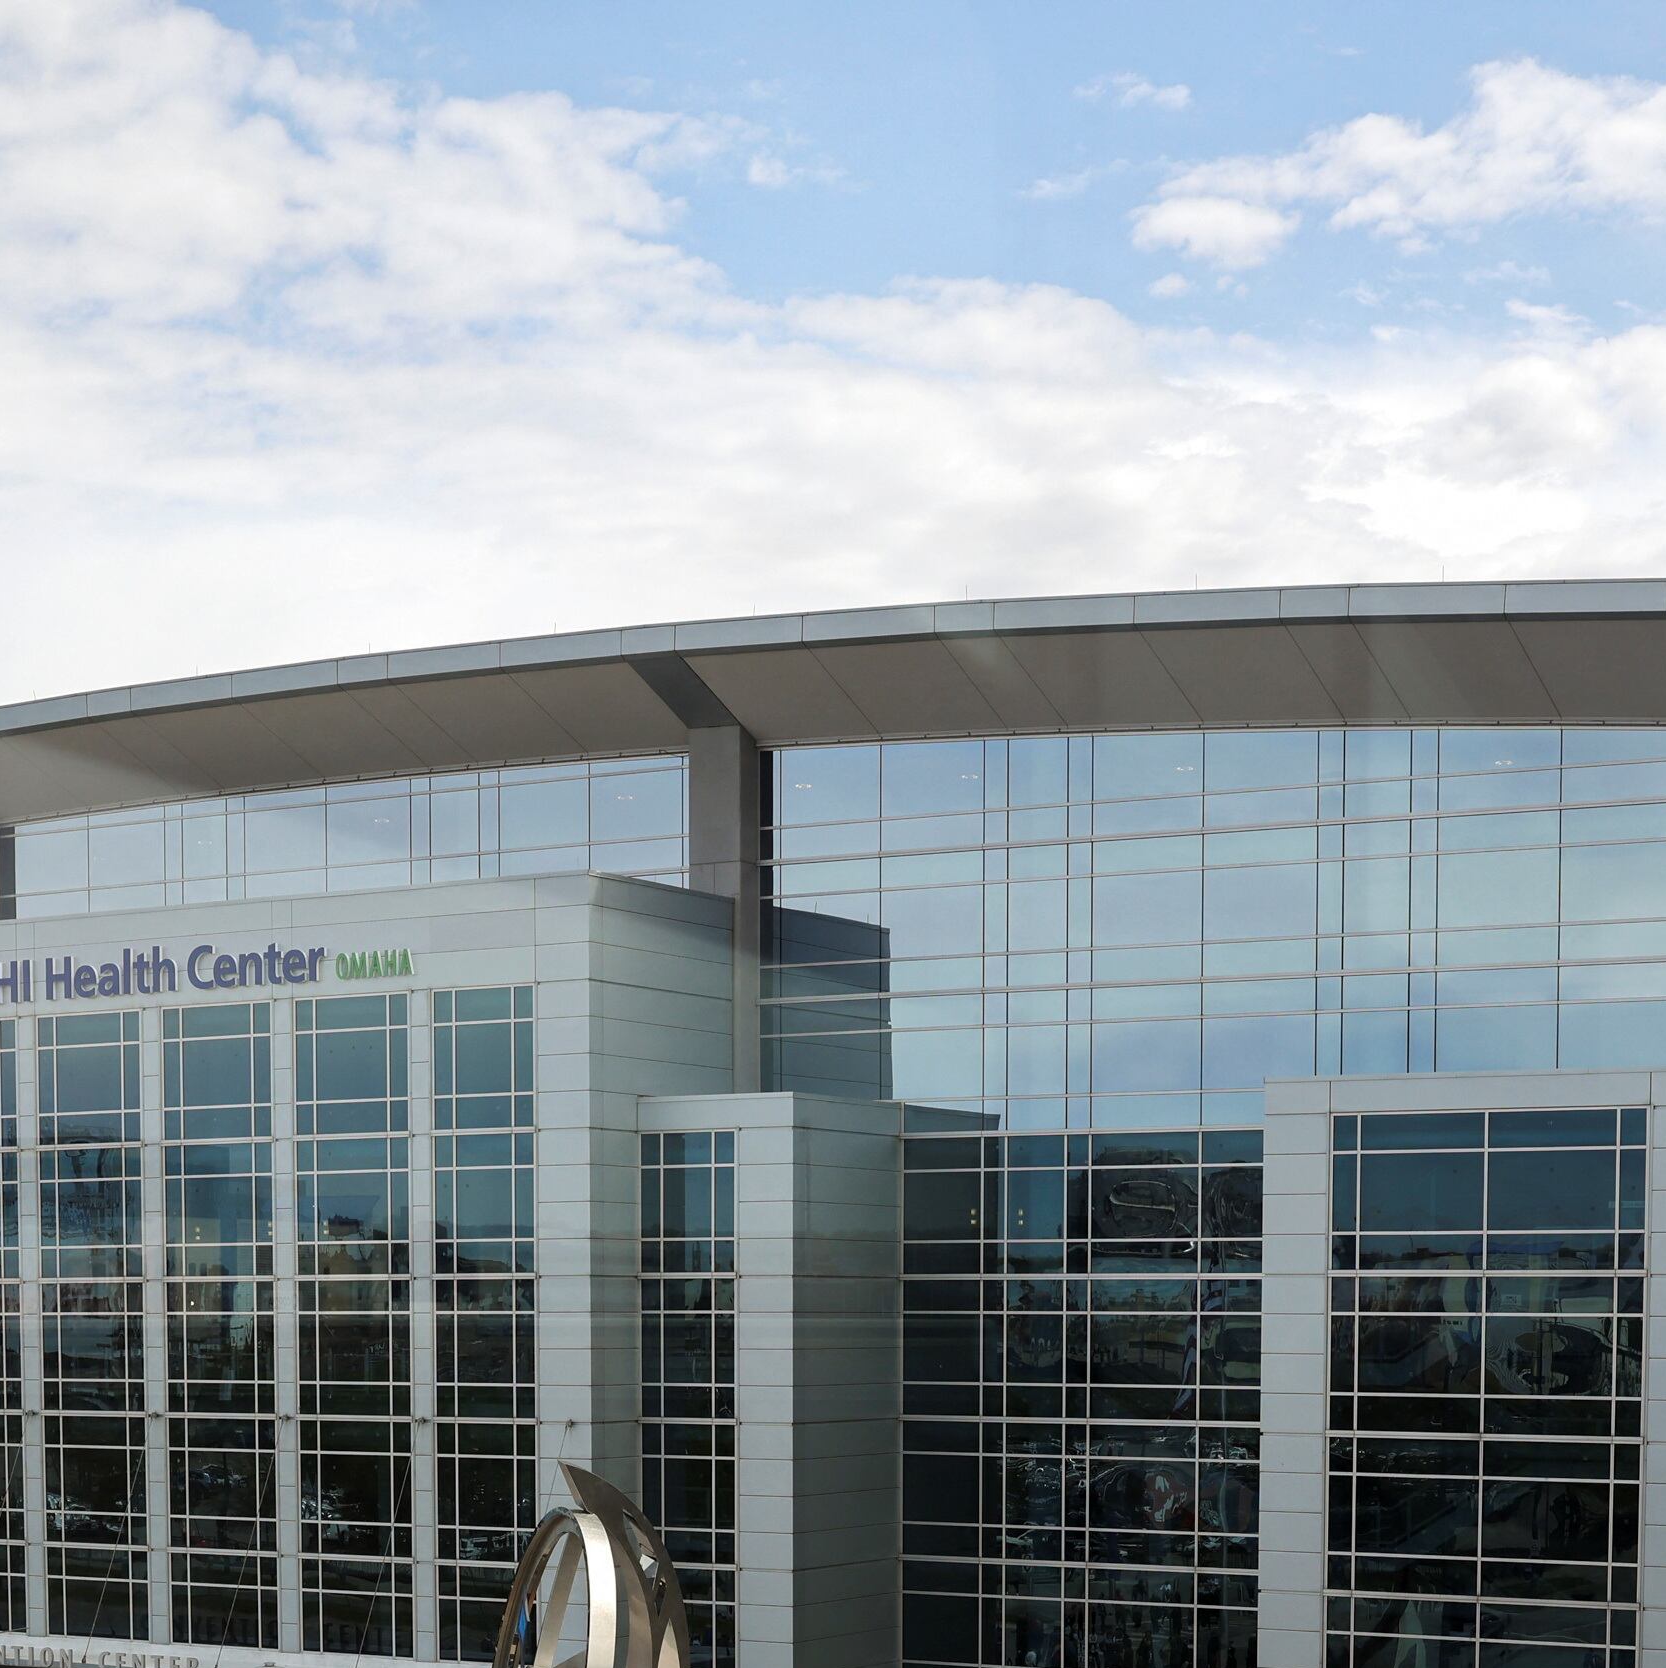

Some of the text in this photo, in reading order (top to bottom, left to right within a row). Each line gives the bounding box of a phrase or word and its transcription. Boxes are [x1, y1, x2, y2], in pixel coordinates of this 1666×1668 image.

[45, 945, 178, 1000] Health
[187, 942, 326, 991] Center
[335, 947, 414, 979] OMAHA
